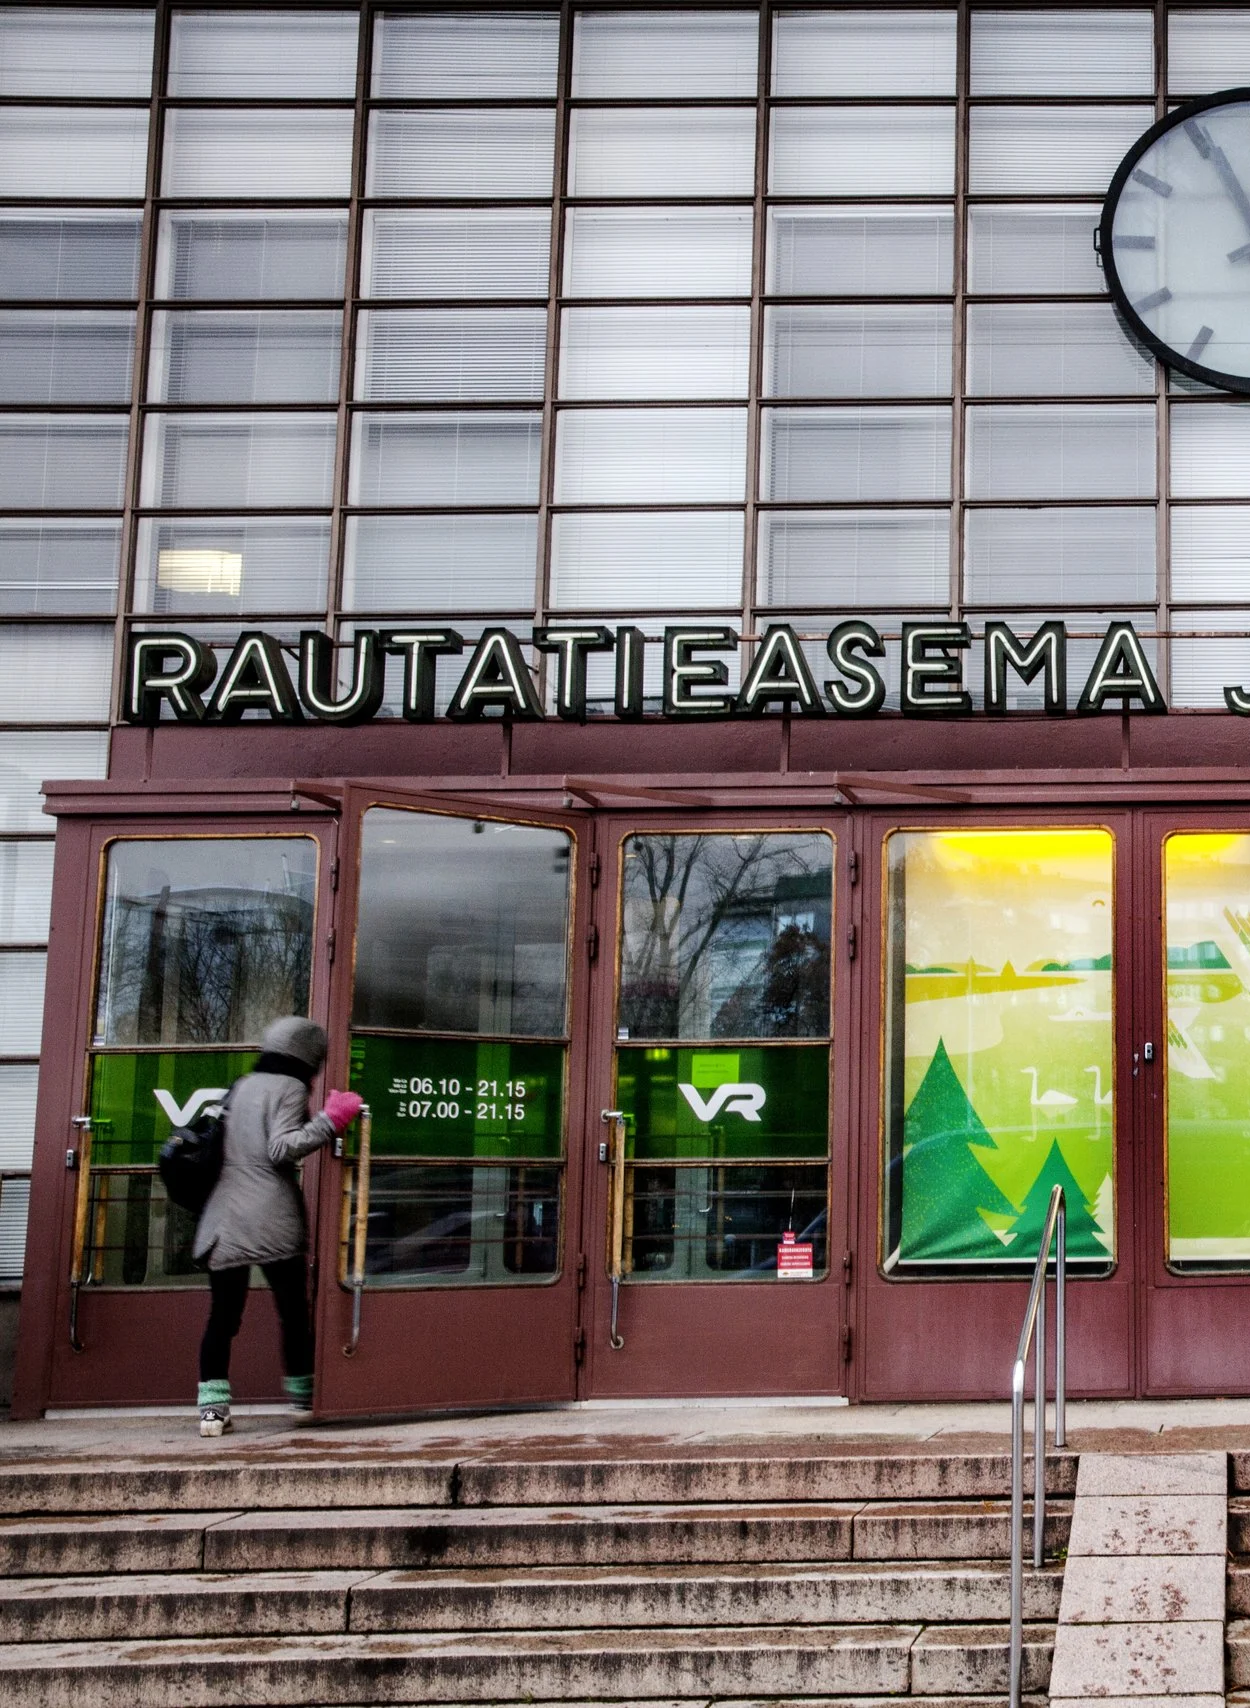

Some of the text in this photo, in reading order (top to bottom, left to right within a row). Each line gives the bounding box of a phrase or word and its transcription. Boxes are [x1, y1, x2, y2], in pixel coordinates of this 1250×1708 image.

[124, 620, 1168, 726] RAUTATIEASEMA
[410, 1077, 461, 1096] 06.10
[477, 1079, 526, 1098] 21.15
[678, 1083, 767, 1122] VR
[408, 1100, 460, 1119] 07.00
[476, 1102, 526, 1120] 21.15
